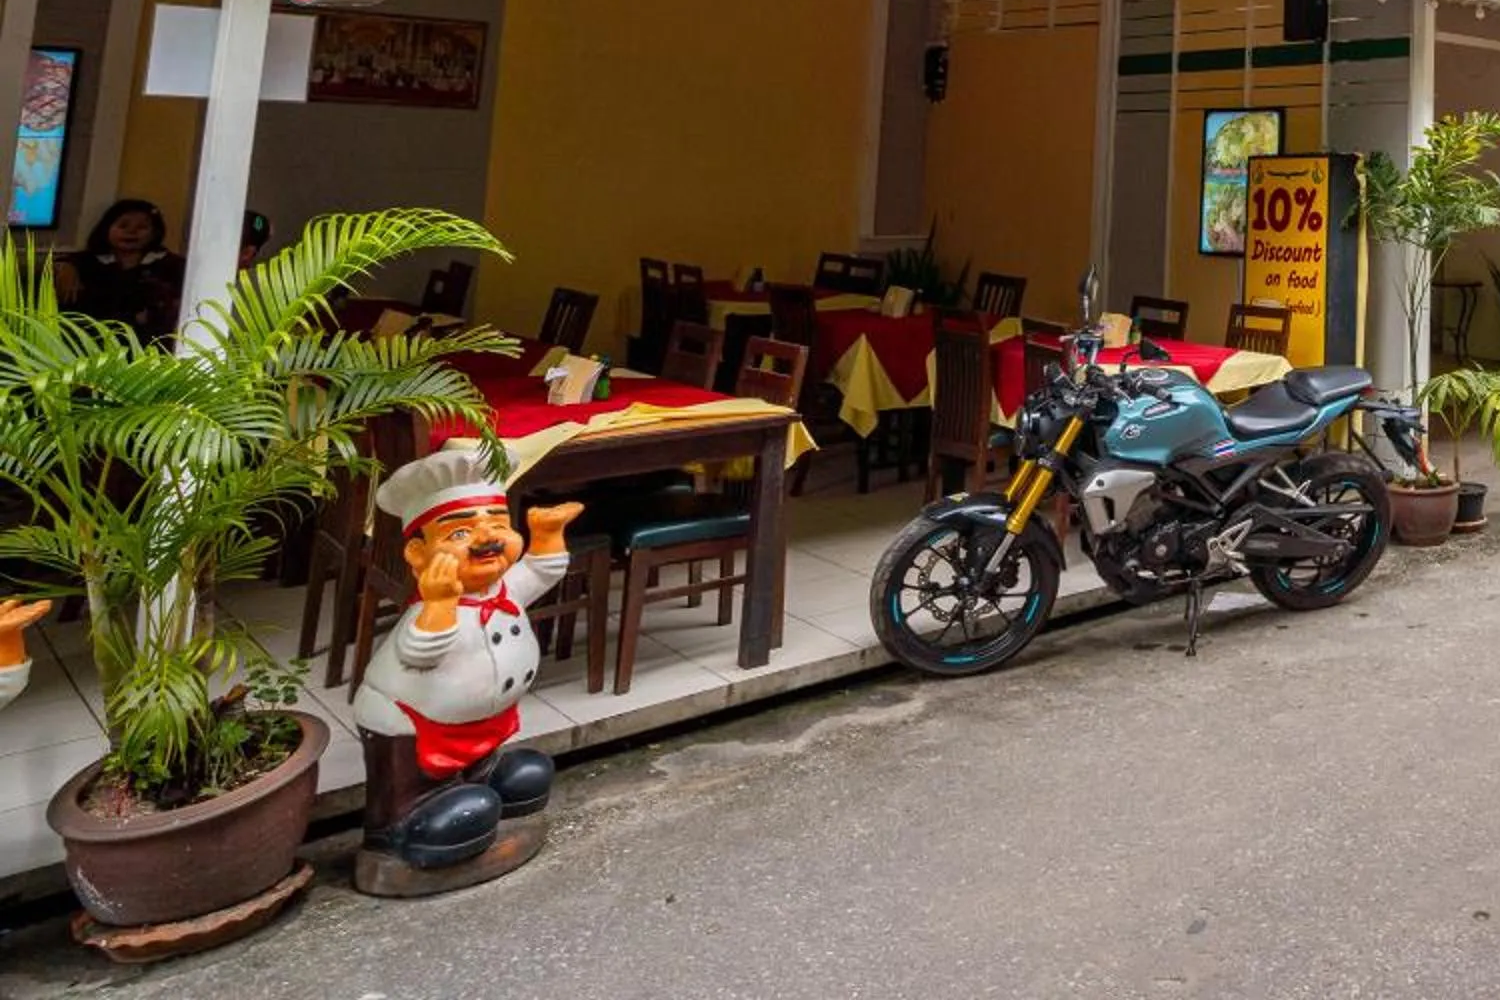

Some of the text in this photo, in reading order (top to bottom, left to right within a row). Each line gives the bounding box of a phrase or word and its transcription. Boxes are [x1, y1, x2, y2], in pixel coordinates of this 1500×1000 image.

[1252, 187, 1323, 232] 10%
[1251, 239, 1322, 262] Discount
[1265, 270, 1318, 289] on food
